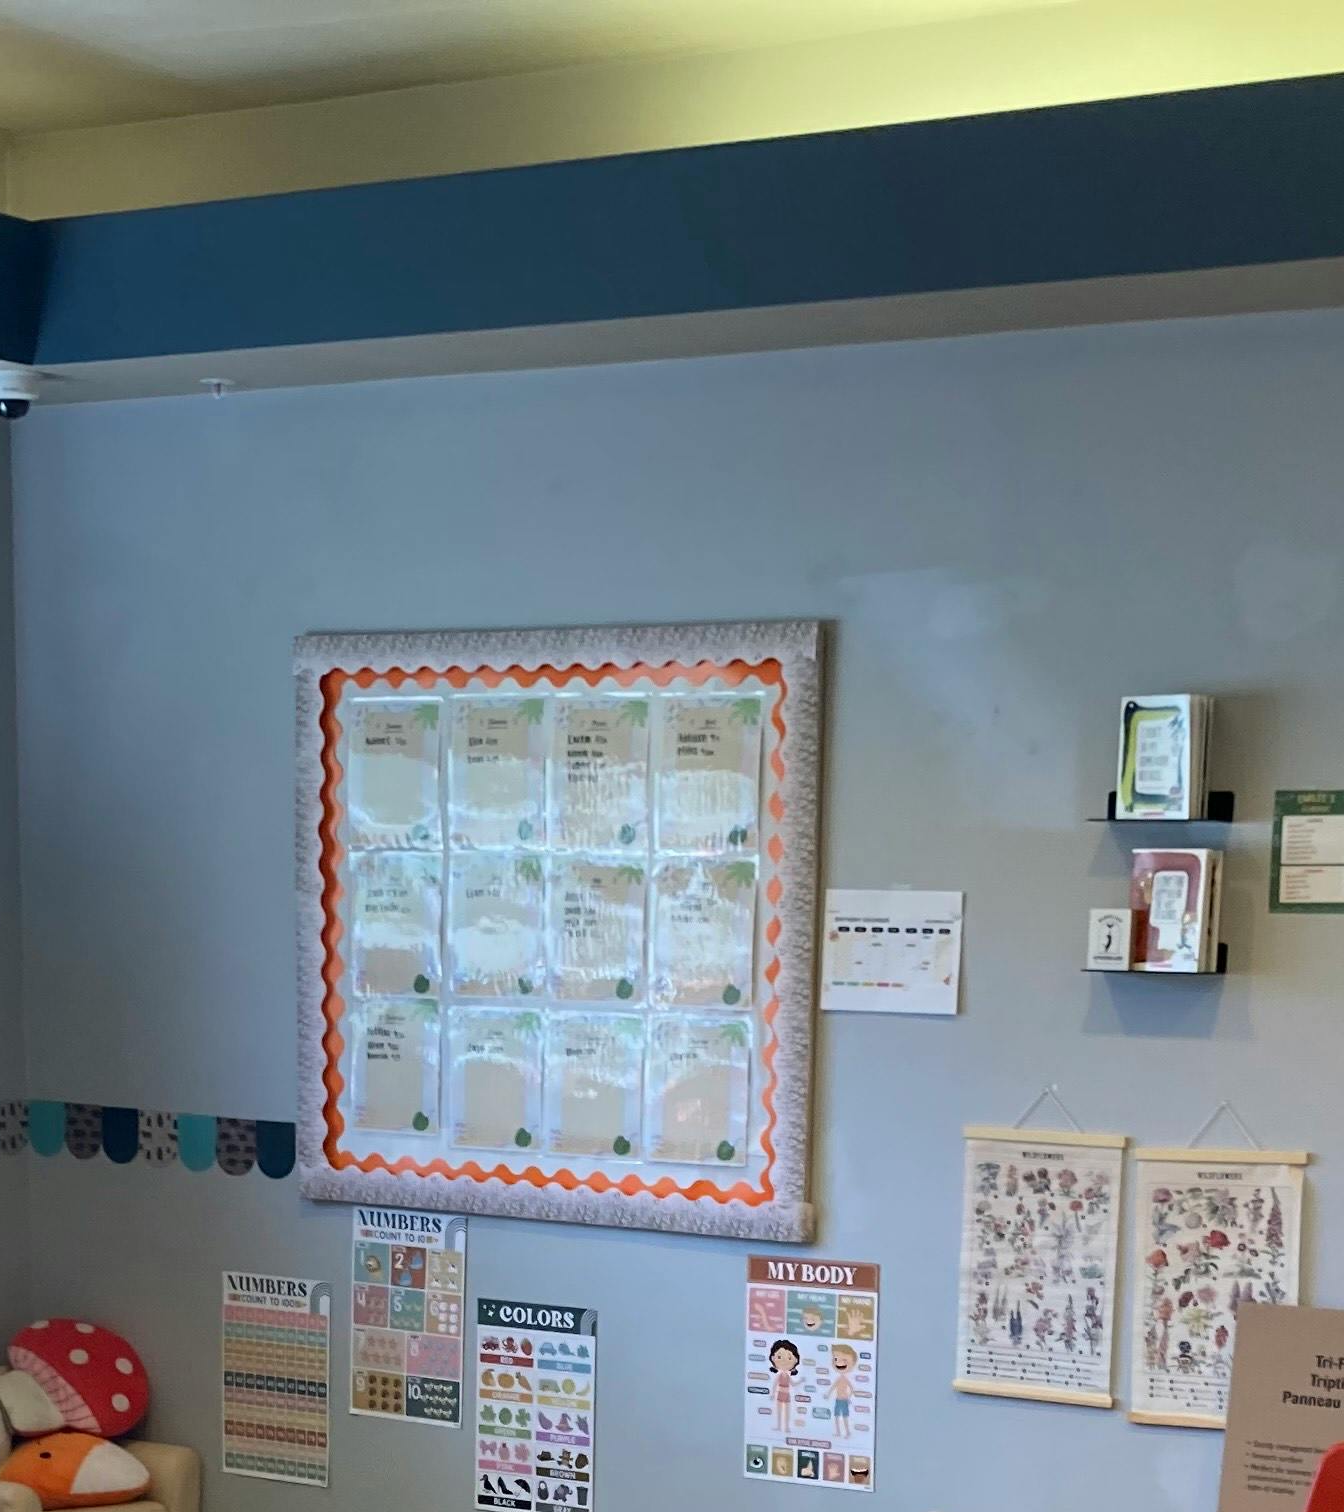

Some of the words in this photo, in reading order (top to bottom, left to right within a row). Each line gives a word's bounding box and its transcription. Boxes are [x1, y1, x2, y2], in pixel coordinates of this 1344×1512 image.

[358, 1209, 442, 1233] NUMBERS
[375, 1229, 401, 1240] COUNT
[405, 1233, 415, 1243] TO
[417, 1235, 426, 1243] 10
[394, 1253, 404, 1270] 2
[768, 1261, 799, 1281] MY
[801, 1264, 857, 1285] BODY
[227, 1274, 307, 1297] NUMBERS
[241, 1294, 267, 1305] COUNT
[270, 1297, 280, 1306] TO
[282, 1298, 296, 1308] 100
[394, 1296, 402, 1312] 5
[499, 1305, 575, 1329] COLORS
[407, 1383, 422, 1400] 10
[1283, 1391, 1342, 1408] Panneau
[550, 1469, 576, 1479] BROWN
[494, 1498, 516, 1507] BLACK
